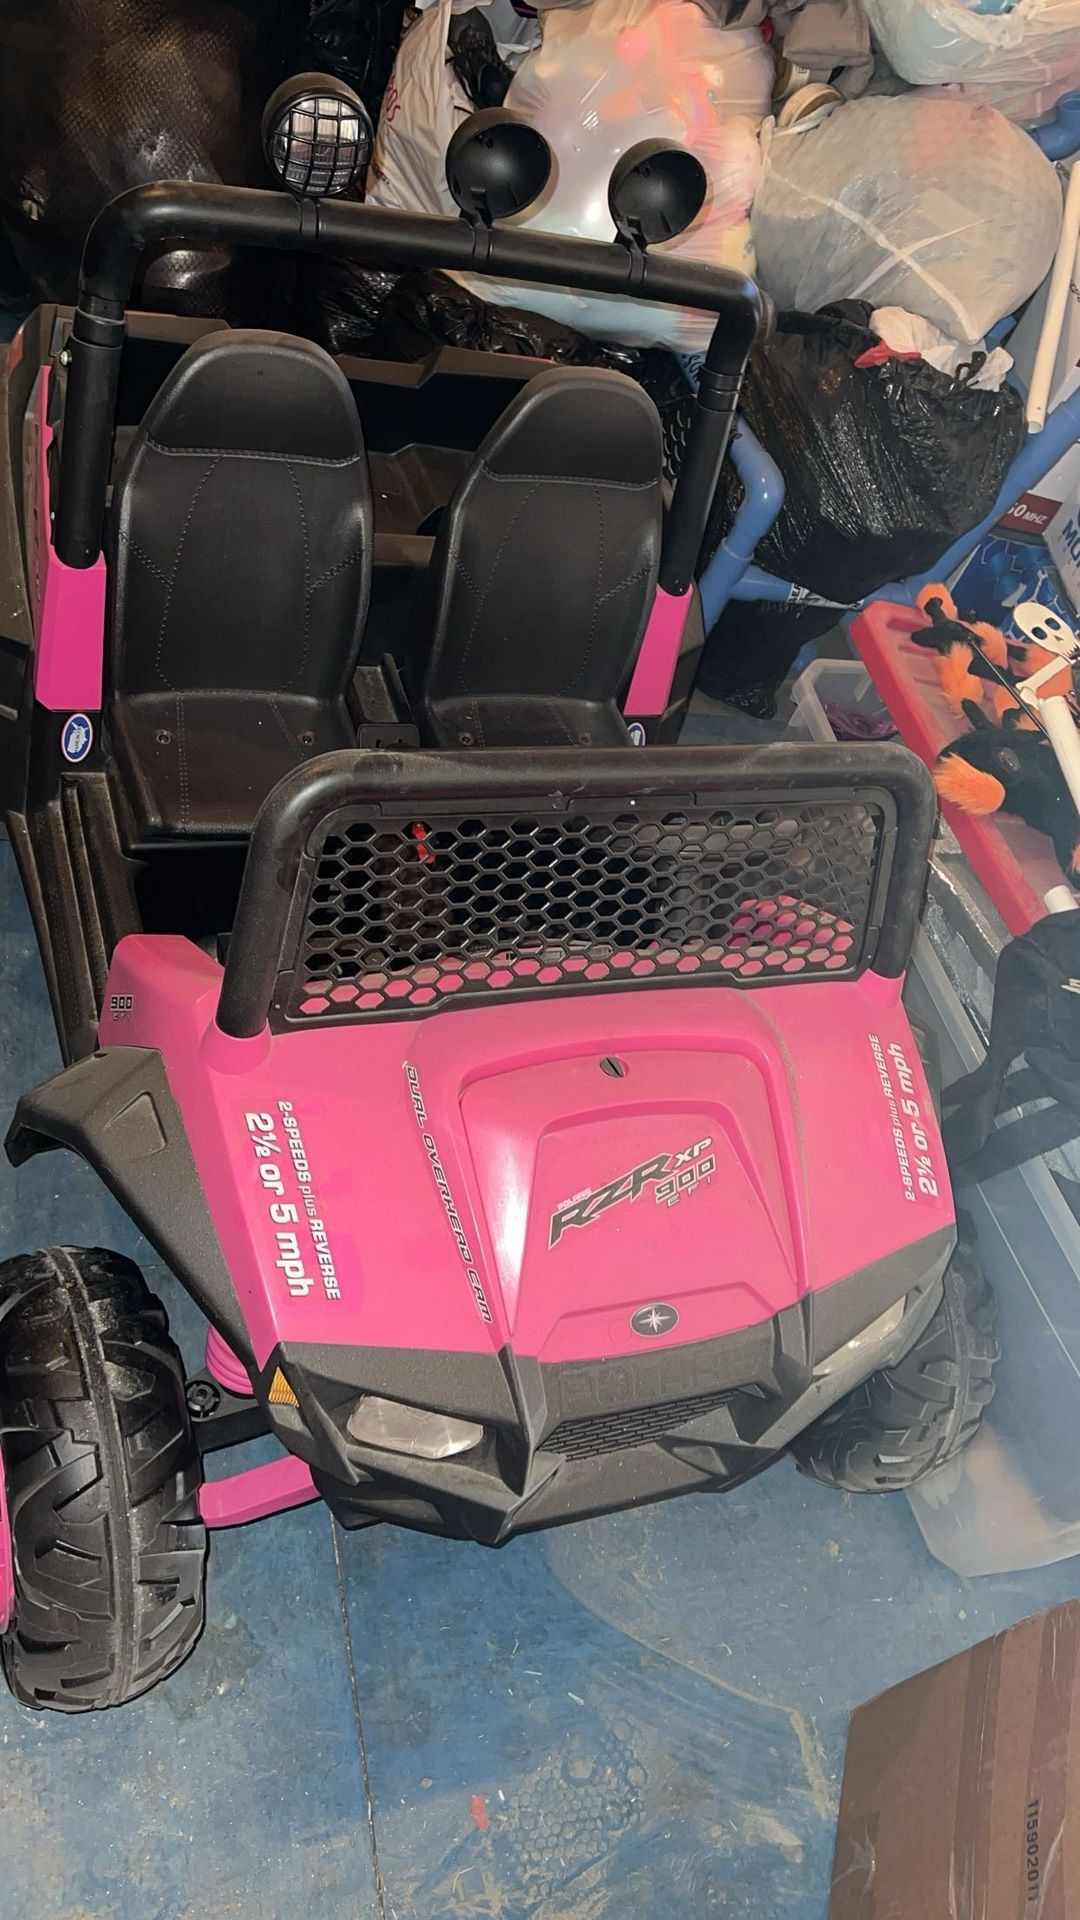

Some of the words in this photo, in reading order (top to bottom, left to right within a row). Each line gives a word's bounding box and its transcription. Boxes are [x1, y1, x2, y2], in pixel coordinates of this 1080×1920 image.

[1022, 511, 1048, 525] MHZ
[1062, 519, 1080, 569] MO
[110, 994, 133, 1011] 900
[868, 1033, 894, 1098] REVERSE
[887, 1042, 914, 1093] mph
[887, 1099, 900, 1126] plus
[901, 1099, 920, 1117] 5
[911, 1121, 929, 1150] or
[258, 1164, 286, 1197] or
[655, 1154, 717, 1205] 900
[892, 1128, 916, 1202] 2-SPEEDS
[270, 1203, 299, 1224] 5
[277, 1100, 313, 1183] 2-SPEEDS
[297, 1185, 318, 1216] plus
[309, 1219, 342, 1301] REVERSE
[404, 1064, 427, 1128] DUAL
[421, 1133, 474, 1264] OVERHEAD
[467, 1268, 493, 1325] CAM
[548, 1152, 678, 1251] RZR
[670, 1136, 714, 1171] XP
[277, 1234, 315, 1298] mph
[1026, 1799, 1040, 1902] 115902011
